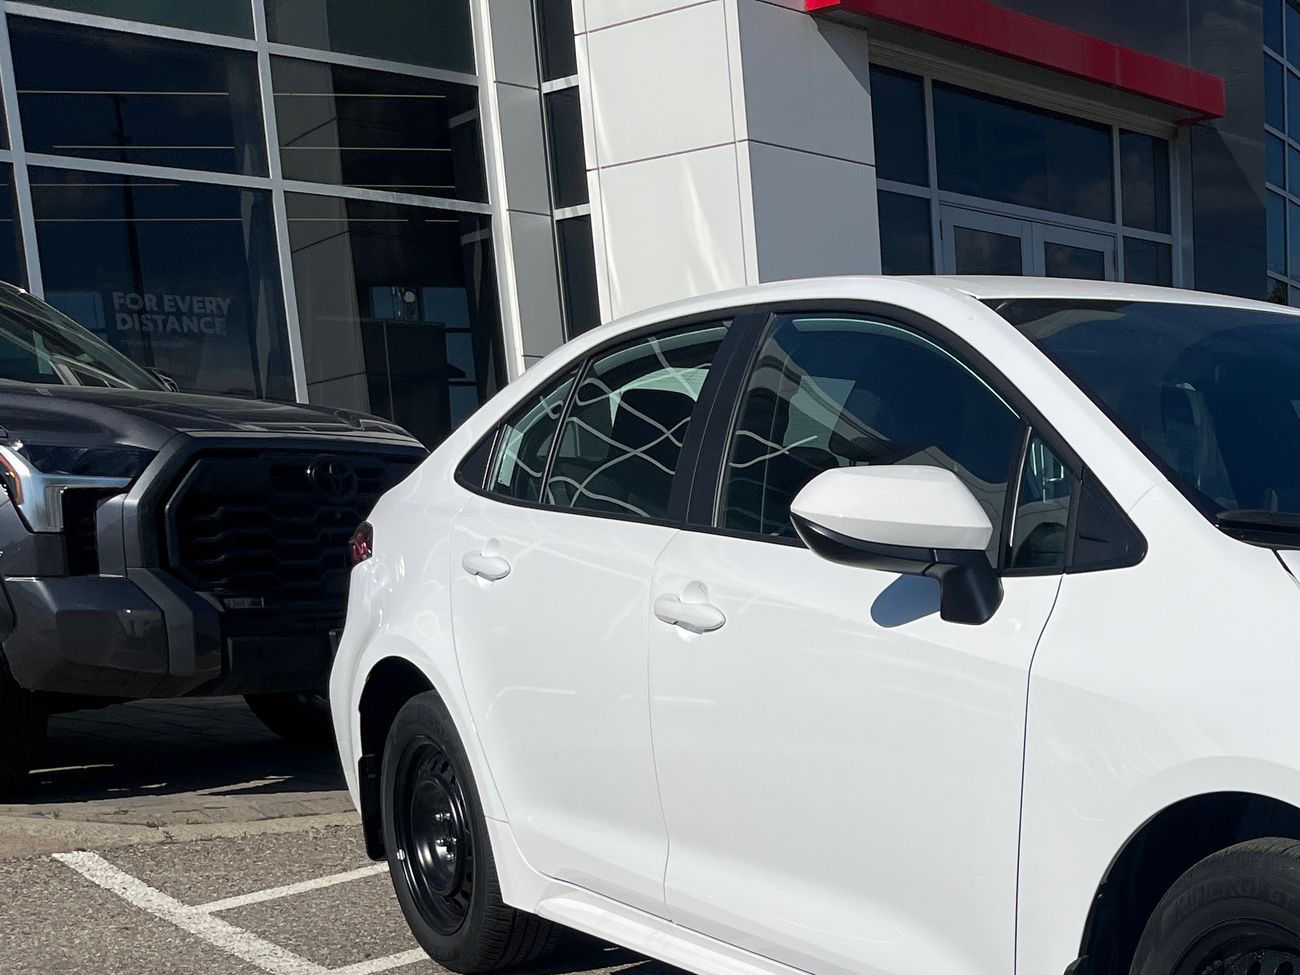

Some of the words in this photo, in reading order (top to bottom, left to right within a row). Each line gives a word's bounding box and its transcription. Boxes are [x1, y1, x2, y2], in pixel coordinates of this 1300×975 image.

[112, 292, 158, 311] FOR
[163, 294, 231, 315] EVERY
[116, 313, 227, 335] DISTANCE
